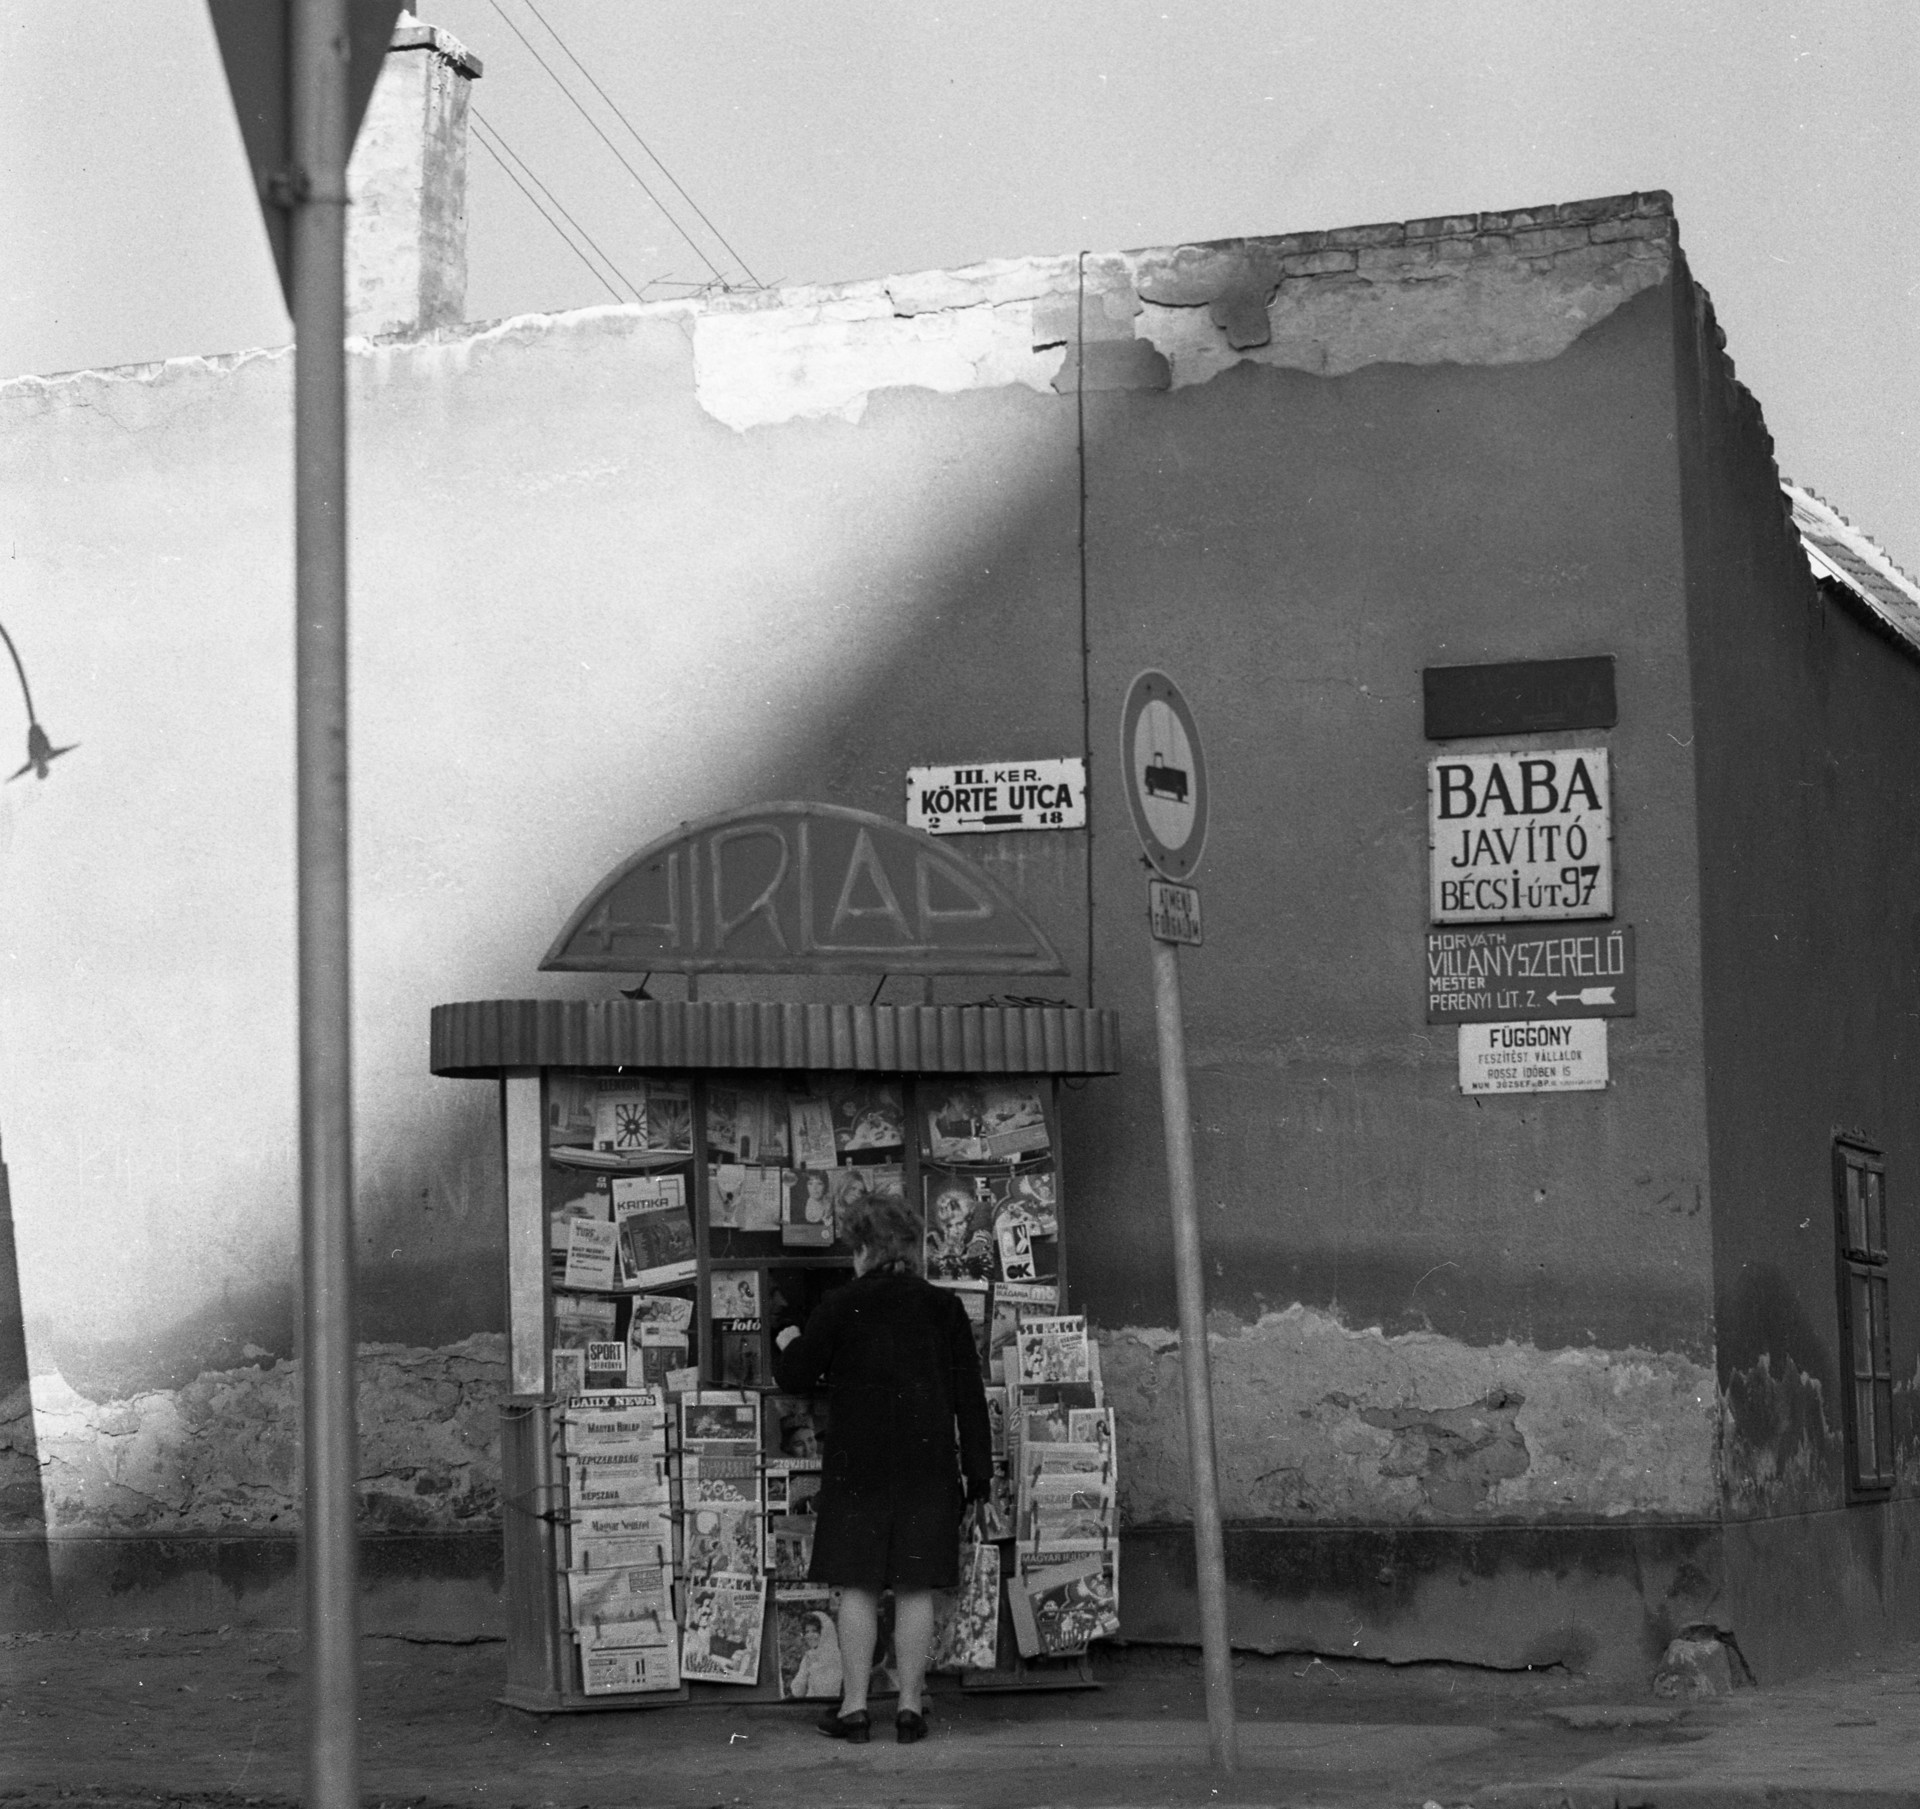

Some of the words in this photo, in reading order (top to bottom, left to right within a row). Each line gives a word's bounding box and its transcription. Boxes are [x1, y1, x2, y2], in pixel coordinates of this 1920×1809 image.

[954, 769, 989, 785] III.
[994, 768, 1042, 783] KER.
[921, 785, 998, 815] KÖRTE
[1009, 783, 1074, 810] UTCA
[1436, 757, 1603, 820] BABA
[928, 816, 941, 829] 2
[1037, 811, 1064, 825] 18
[1451, 814, 1588, 868] JAVÍTÓ
[1560, 864, 1601, 908] 97
[1429, 932, 1507, 952] HORVÁTH
[1427, 930, 1624, 977] VILLANYSZERELŐ
[1429, 976, 1486, 993] MESTER
[1430, 989, 1492, 1011] PERÉNYI
[1490, 1025, 1572, 1048] FÜGGÖNY
[1487, 1067, 1518, 1080] ROSSZ
[590, 1344, 622, 1360] SPORT
[571, 1397, 611, 1408] DAILY
[614, 1395, 655, 1407] NEWS
